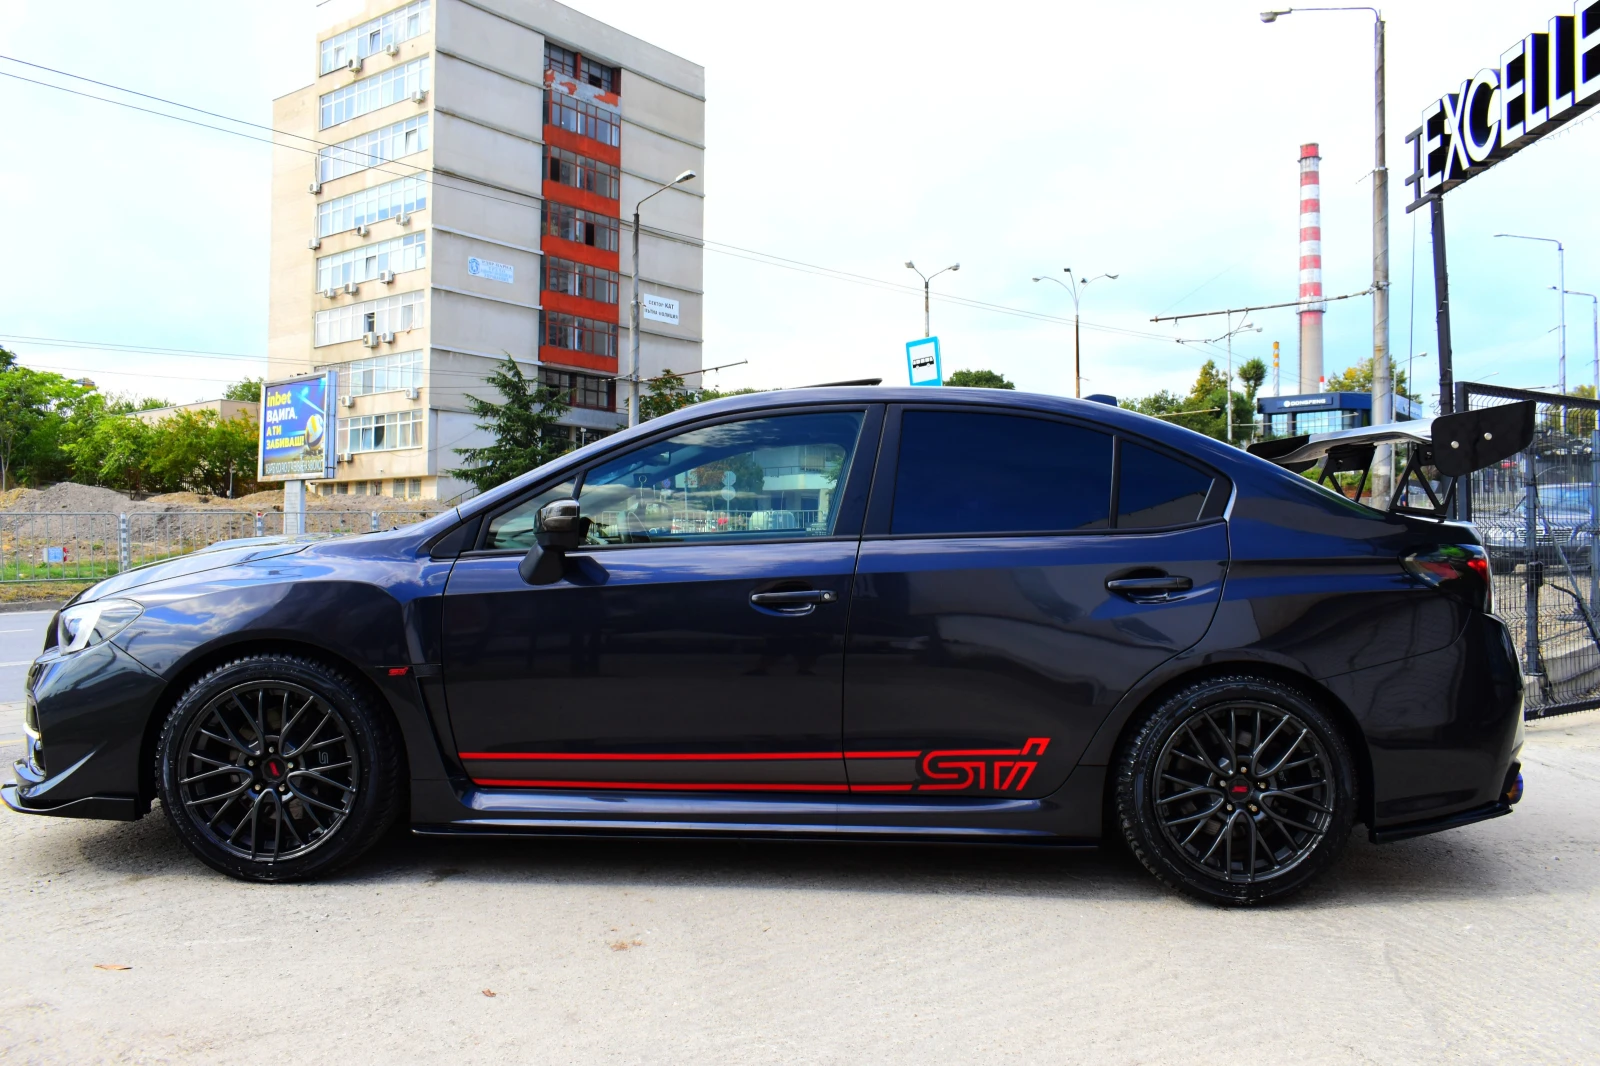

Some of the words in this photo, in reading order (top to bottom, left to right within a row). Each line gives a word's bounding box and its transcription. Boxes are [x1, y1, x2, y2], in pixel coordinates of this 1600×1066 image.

[664, 302, 674, 310] КАТ
[267, 391, 291, 407] inbet
[1290, 398, 1326, 406] DONGFENG
[266, 436, 305, 449] ЗАБИВАШ!
